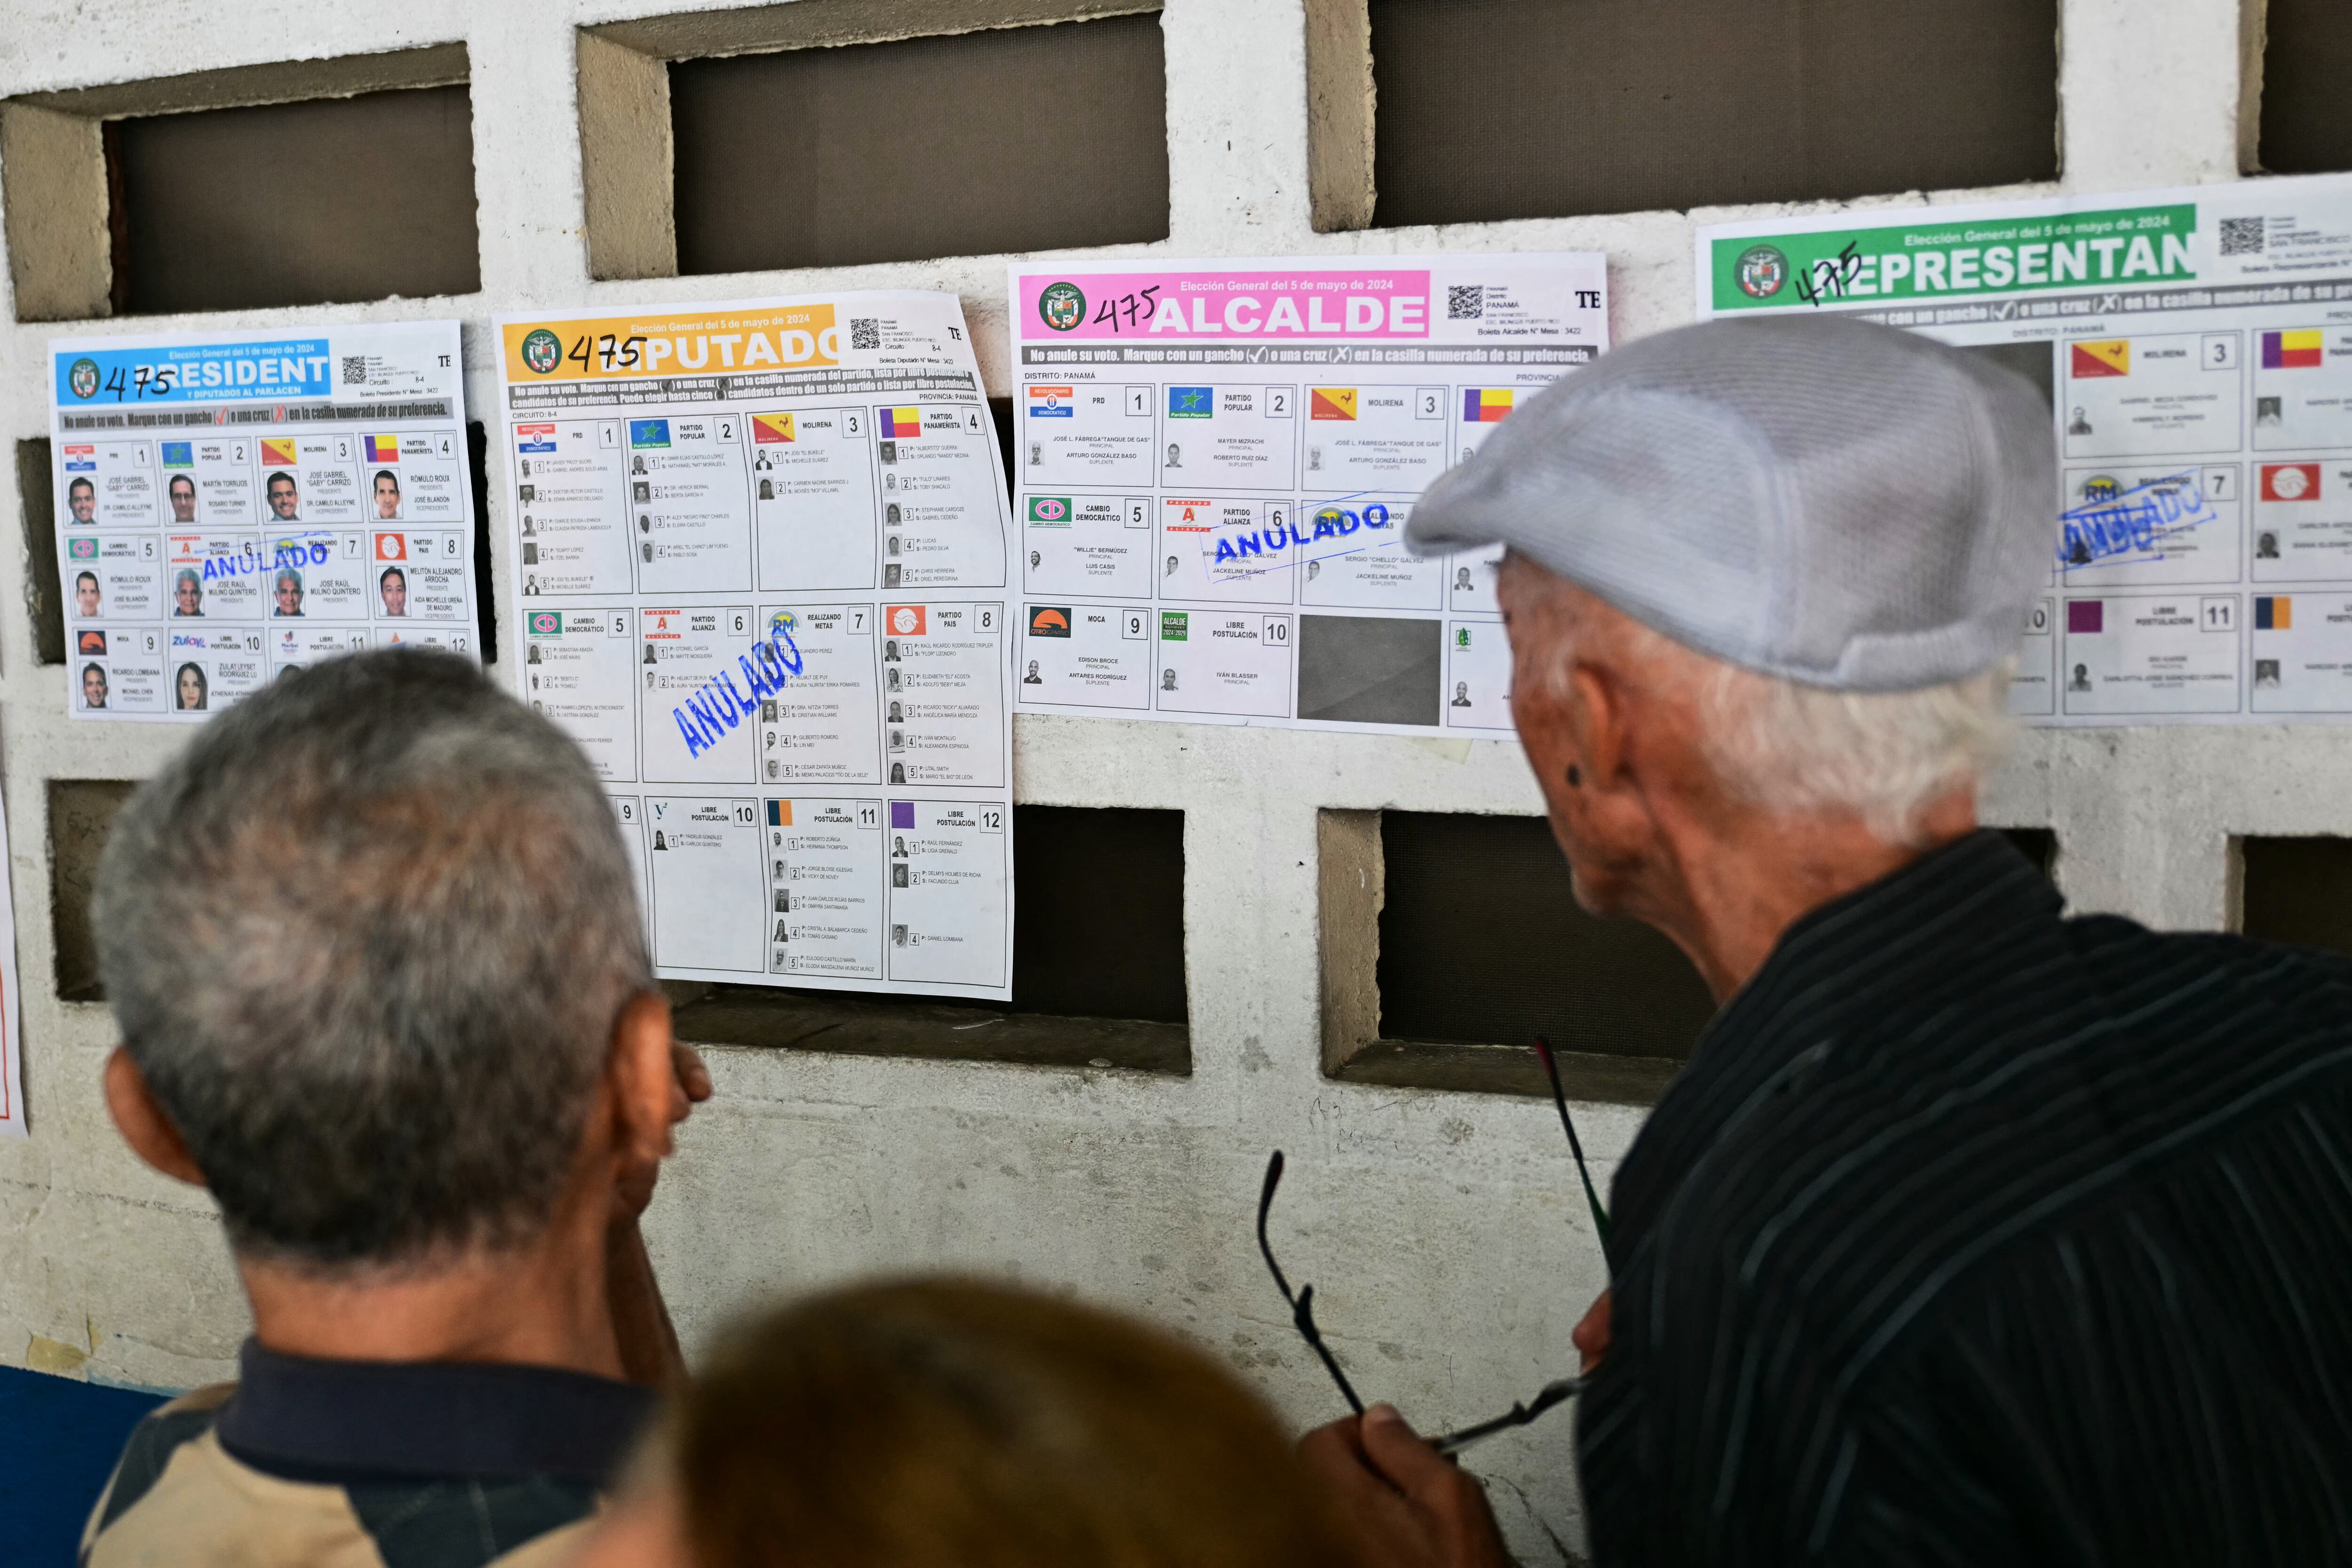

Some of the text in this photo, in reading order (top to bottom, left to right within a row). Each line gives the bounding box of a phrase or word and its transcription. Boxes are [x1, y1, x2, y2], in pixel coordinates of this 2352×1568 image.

[1796, 240, 1861, 307] 475
[1181, 279, 1393, 292] Elección General del 5 de mayo de 2024
[1575, 291, 1600, 309] TE
[1093, 285, 1160, 333] 475
[1149, 296, 1425, 333] ALCALDE
[631, 324, 667, 333] Elección
[669, 322, 703, 332] General
[706, 320, 719, 329] del
[729, 319, 740, 327] de
[742, 317, 769, 329] mayo
[772, 316, 784, 325] de
[787, 313, 810, 324] 2024
[948, 326, 961, 341] TE
[169, 350, 200, 359] Elección
[262, 347, 282, 356] mayo
[297, 344, 314, 353] 2024
[568, 334, 647, 372] 475
[1031, 349, 1044, 362] No
[1047, 349, 1077, 362] anule
[1080, 350, 1092, 361] su
[1094, 349, 1120, 362] voto.
[1124, 349, 1164, 363] Marque
[1167, 349, 1186, 362] con
[1189, 349, 1202, 361] un
[1204, 348, 1244, 363] gancho
[1271, 351, 1278, 362] o
[1280, 351, 1301, 362] una
[1303, 350, 1327, 362] cruz
[1354, 350, 1369, 362] en
[1371, 349, 1382, 362] la
[1385, 349, 1425, 363] casilla
[1427, 349, 1487, 363] numerada
[1490, 349, 1505, 362] de
[1507, 350, 1521, 362] su
[2214, 344, 2225, 362] 3
[438, 356, 451, 367] TE
[105, 367, 175, 402] 475
[194, 389, 241, 399] DIPUTADOS
[243, 388, 254, 396] AL
[255, 386, 301, 396] PARLACEN
[1135, 394, 1141, 410] 1
[1274, 396, 1284, 412] 2
[1426, 397, 1435, 413] 3
[850, 417, 858, 432] 3
[970, 414, 977, 429] 4
[606, 428, 611, 443] 1
[722, 424, 731, 438] 2
[237, 446, 243, 459] 2
[340, 443, 347, 457] 3
[442, 440, 449, 454] 4
[2214, 475, 2225, 493] 7
[1076, 513, 1120, 522] DEMOCRÁTICO
[1133, 507, 1142, 523] 5
[1273, 511, 1282, 526] 6
[1214, 503, 1390, 565] ANULADO
[448, 540, 455, 554] 8
[203, 543, 328, 582] ANULADO
[735, 616, 743, 631] 6
[855, 614, 863, 629] 7
[982, 612, 991, 627] 8
[1164, 617, 1186, 626] ALCALDE
[2208, 607, 2229, 625] 11
[565, 625, 604, 633] DEMOCRÁTICO
[616, 618, 623, 633] 5
[1131, 618, 1140, 634] 9
[1268, 624, 1286, 641] 10
[1213, 630, 1258, 639] POSTULACIÓN
[673, 627, 803, 760] ANULADO
[736, 808, 753, 822] 10
[814, 815, 853, 824] POSTULACIÓN
[861, 809, 875, 824] 11
[937, 818, 975, 827] POSTULACIÓN
[983, 812, 1000, 828] 12
